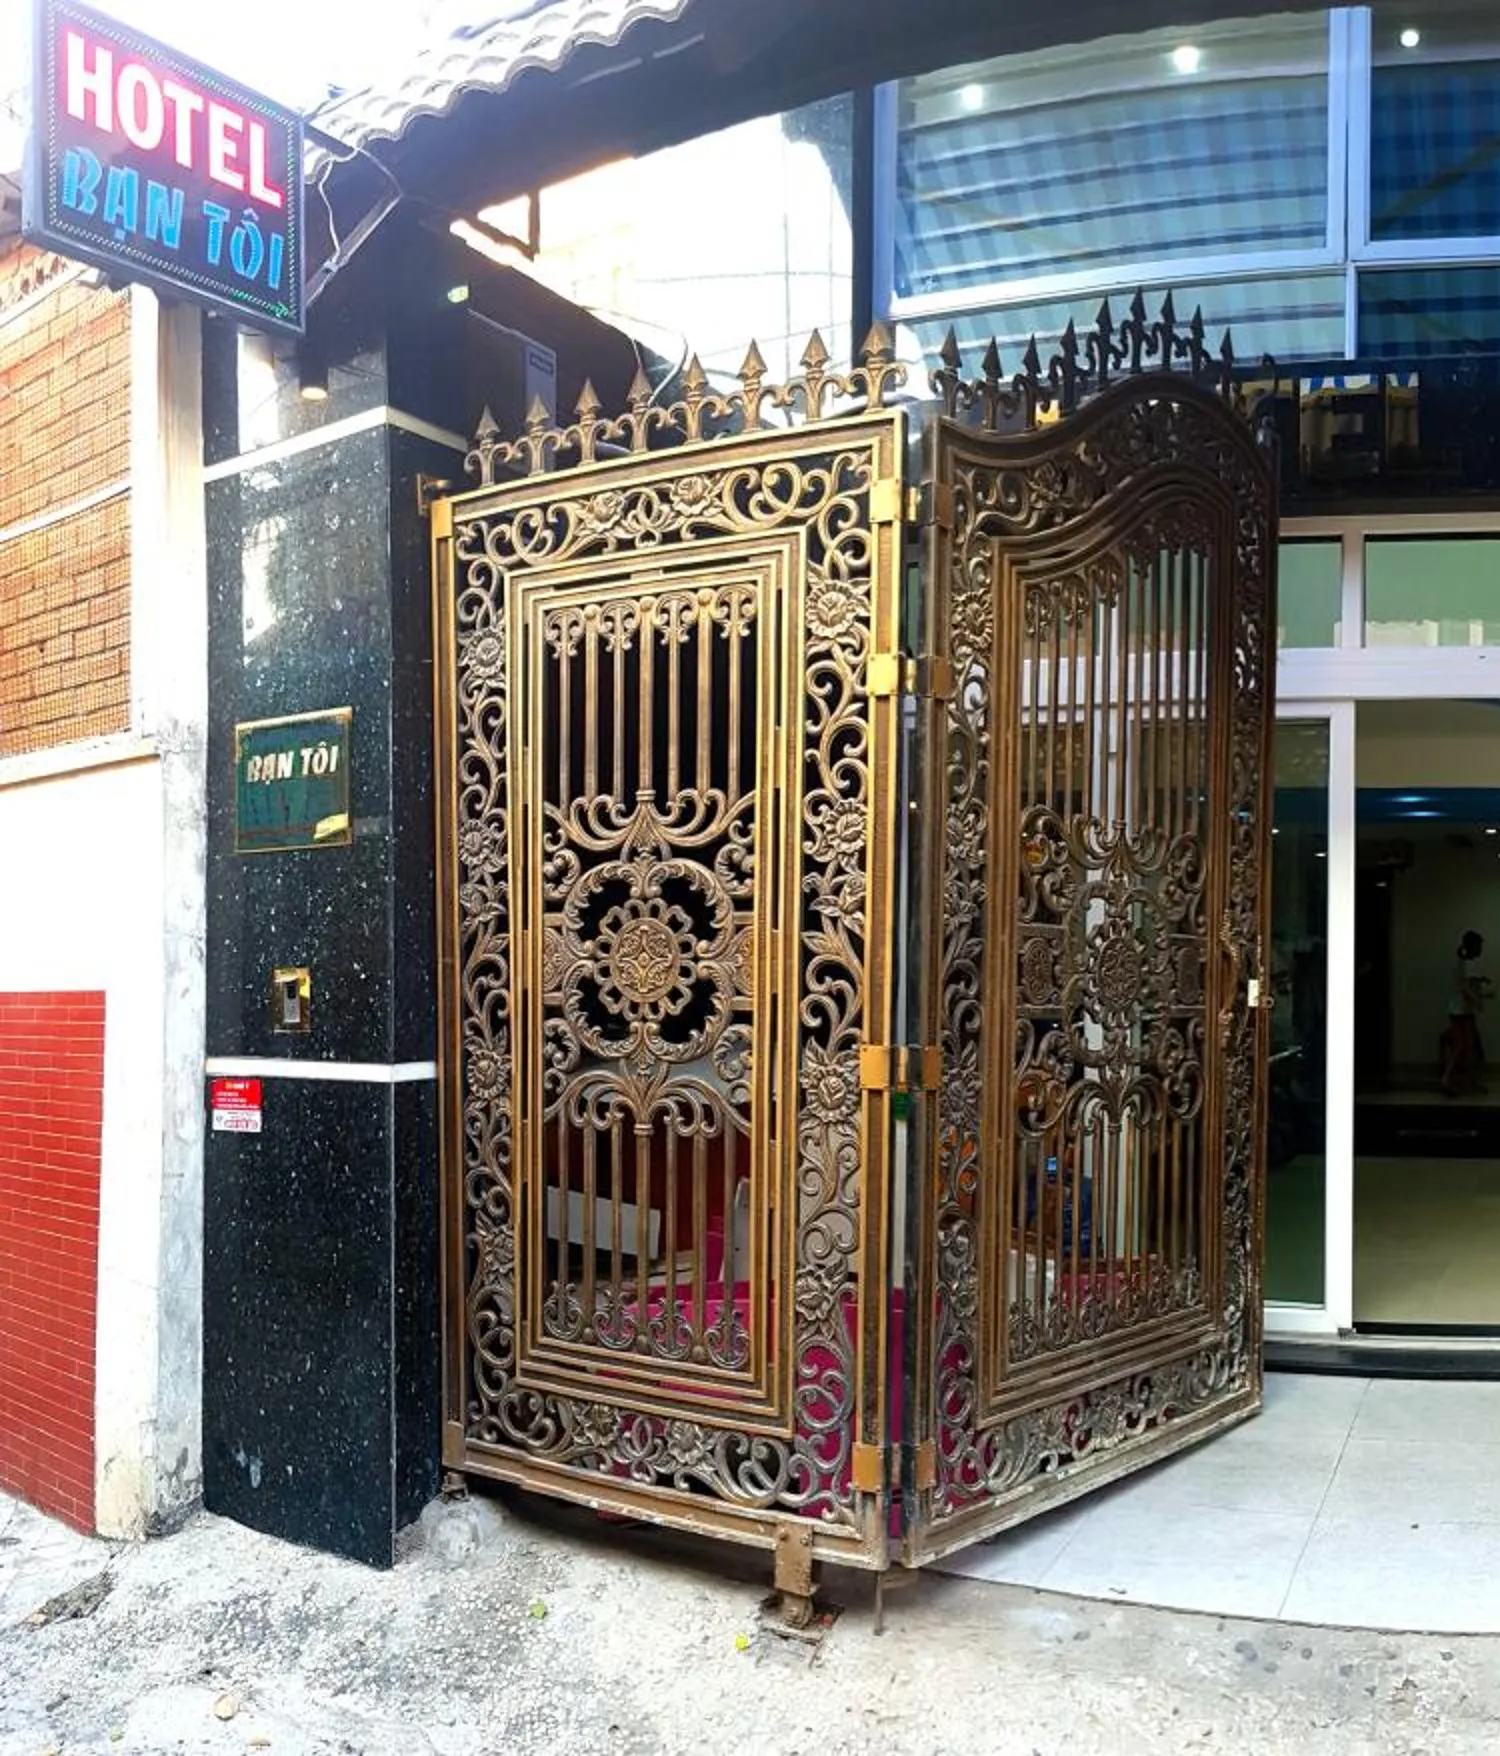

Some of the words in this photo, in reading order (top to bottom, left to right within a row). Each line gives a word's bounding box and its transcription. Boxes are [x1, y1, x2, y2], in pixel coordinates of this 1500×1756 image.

[66, 31, 283, 208] HOTEL
[63, 147, 184, 250] BẠN
[203, 199, 284, 290] TÔI
[247, 751, 294, 785] BẠN
[301, 741, 339, 776] TÔI
